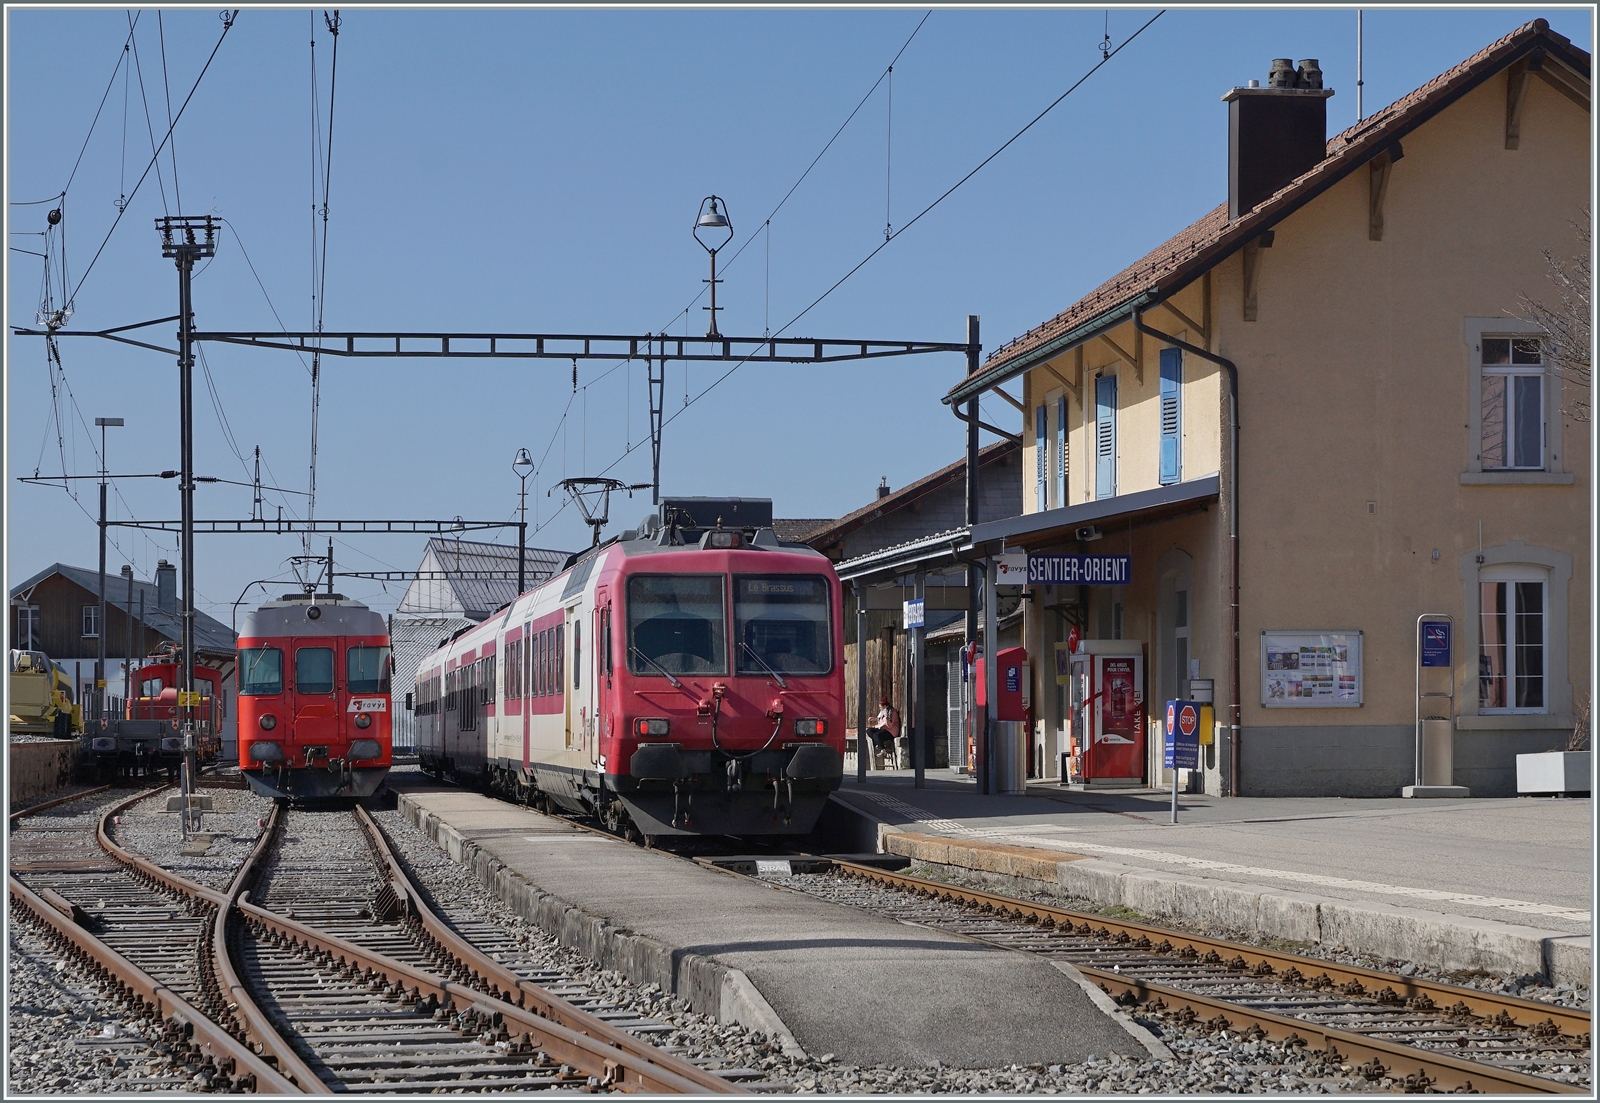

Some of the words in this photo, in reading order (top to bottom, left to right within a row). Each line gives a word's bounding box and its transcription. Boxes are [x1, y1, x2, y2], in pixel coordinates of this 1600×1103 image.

[1029, 557, 1127, 581] SENTIER-ORIENT
[748, 583, 759, 592] Le
[762, 583, 794, 592] Brassus
[1181, 715, 1195, 725] STOP
